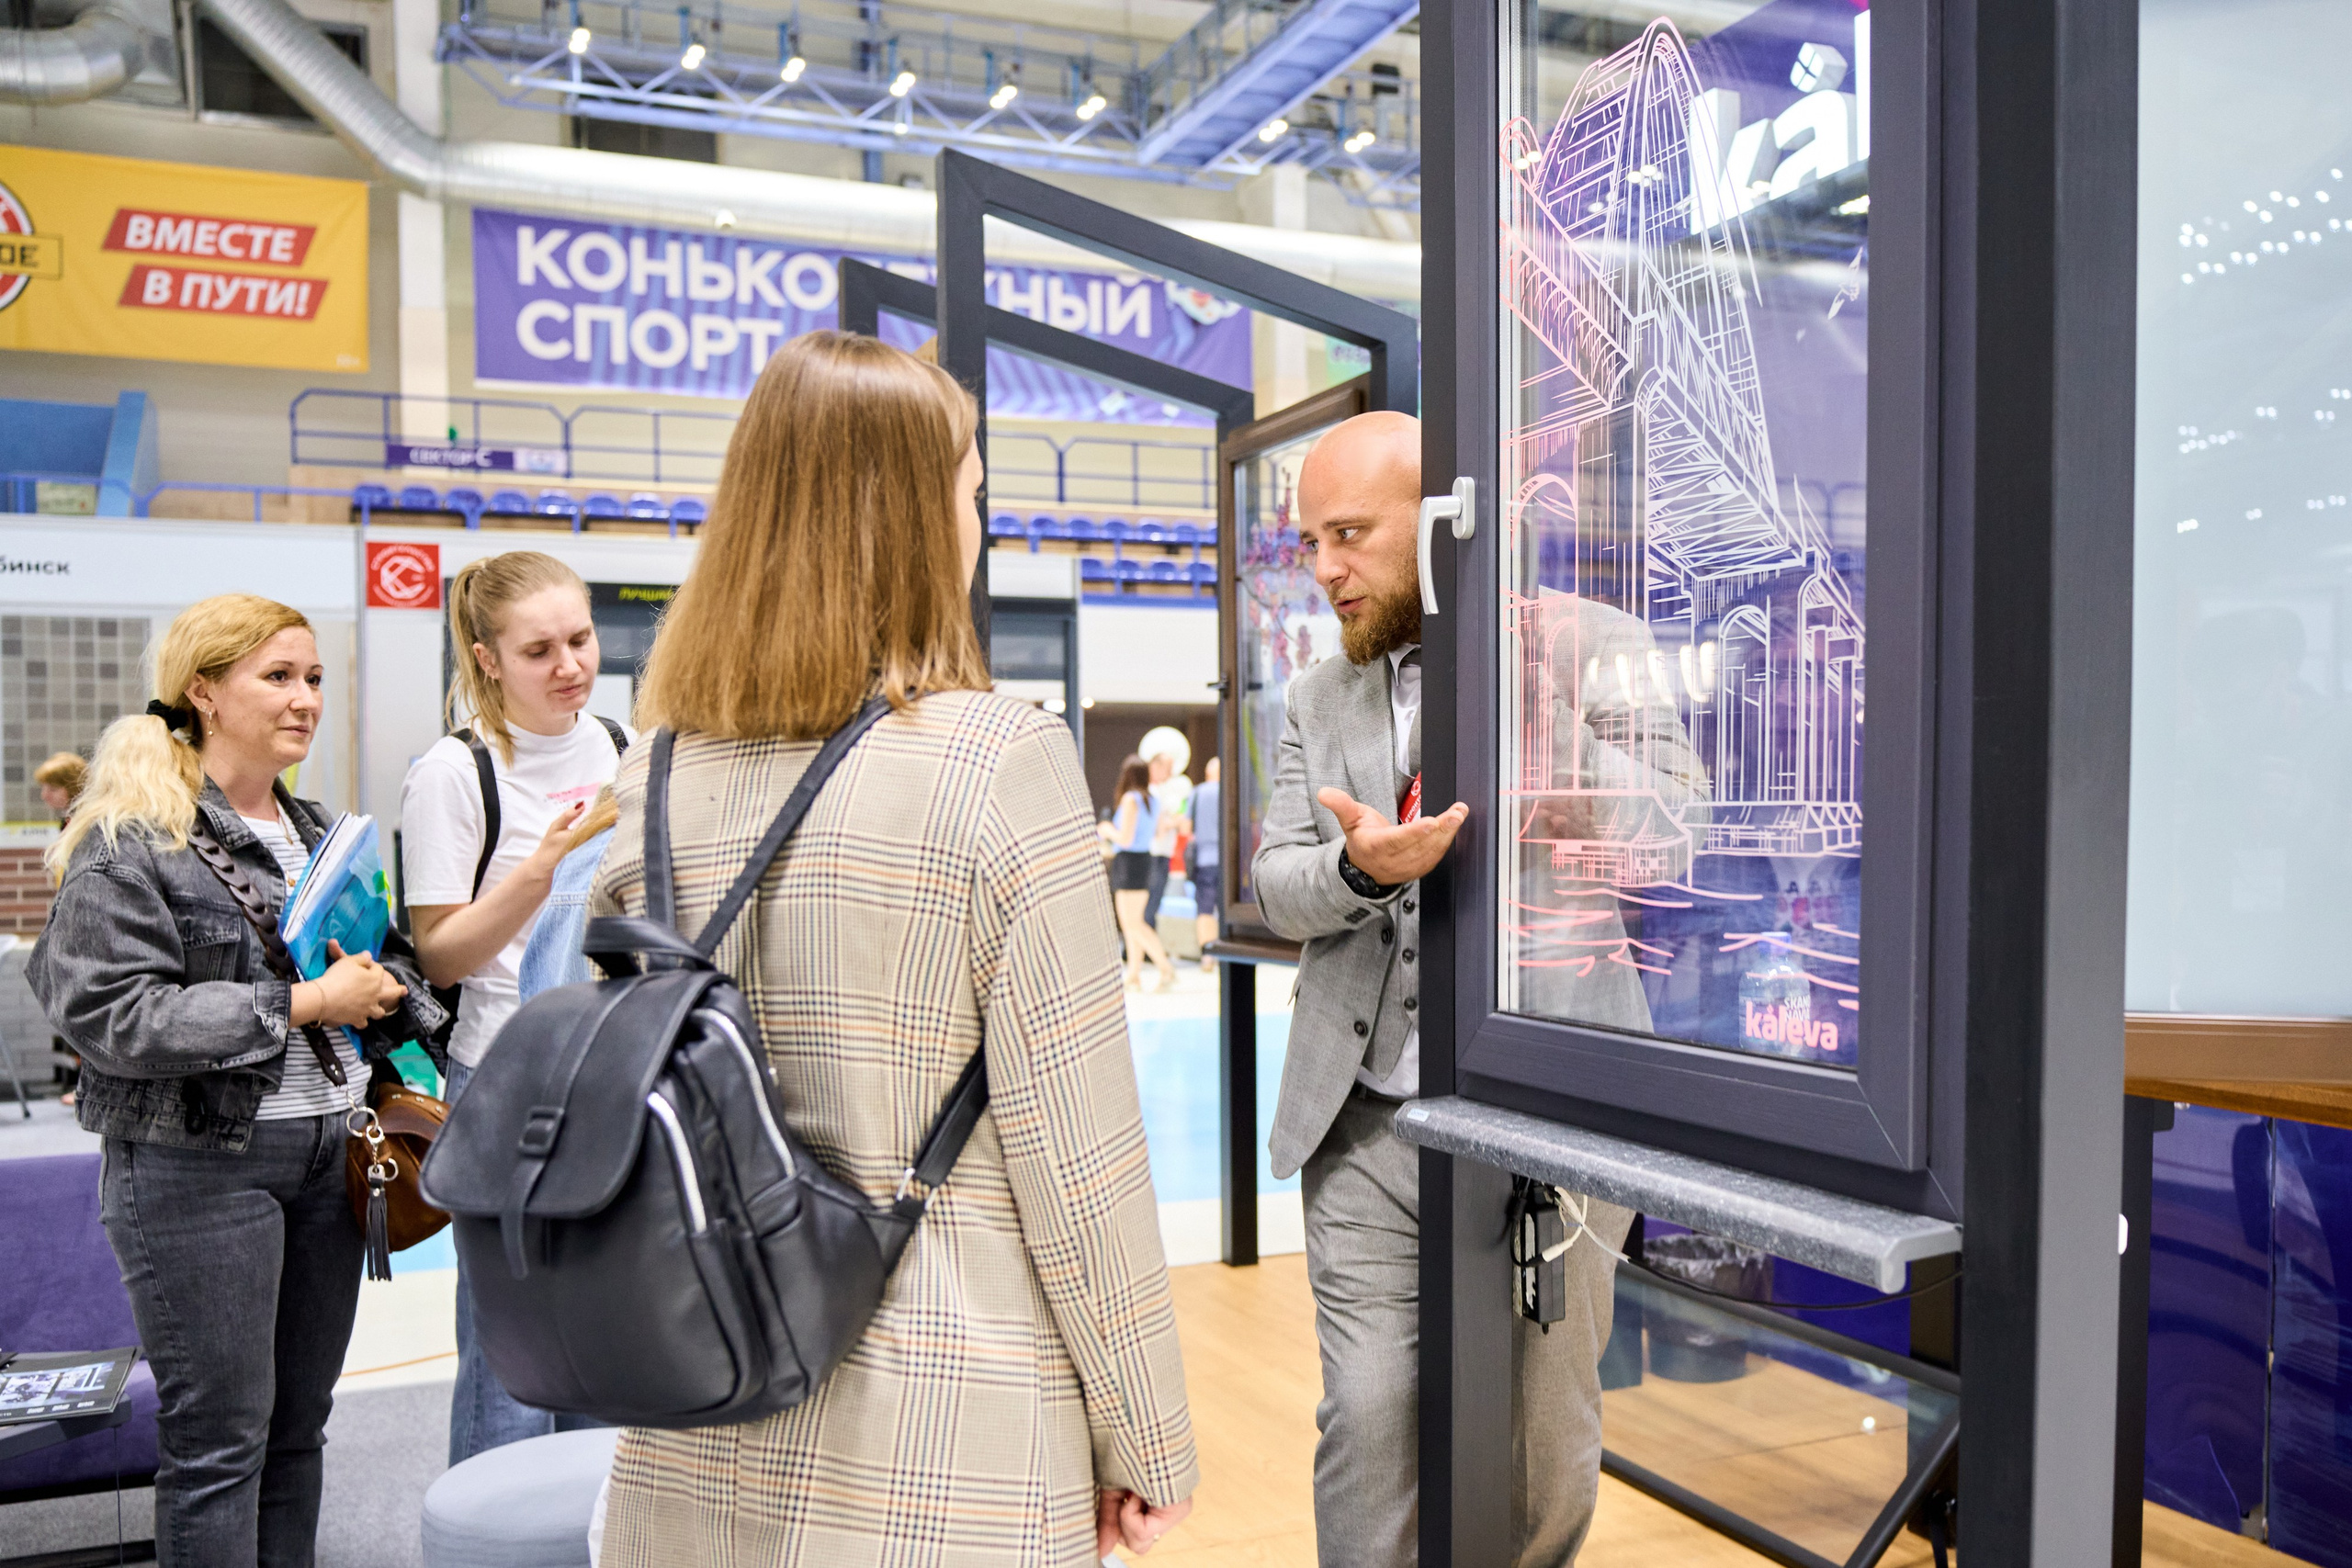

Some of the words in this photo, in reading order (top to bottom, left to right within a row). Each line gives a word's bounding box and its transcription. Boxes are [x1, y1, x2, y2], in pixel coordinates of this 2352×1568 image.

[124, 213, 298, 263] ВМЕСТЕ
[141, 269, 174, 305] В
[179, 274, 312, 317] ПУТИ!
[516, 225, 1152, 338] КОНЬКОНЫЙ
[515, 299, 785, 374] СПОРТ
